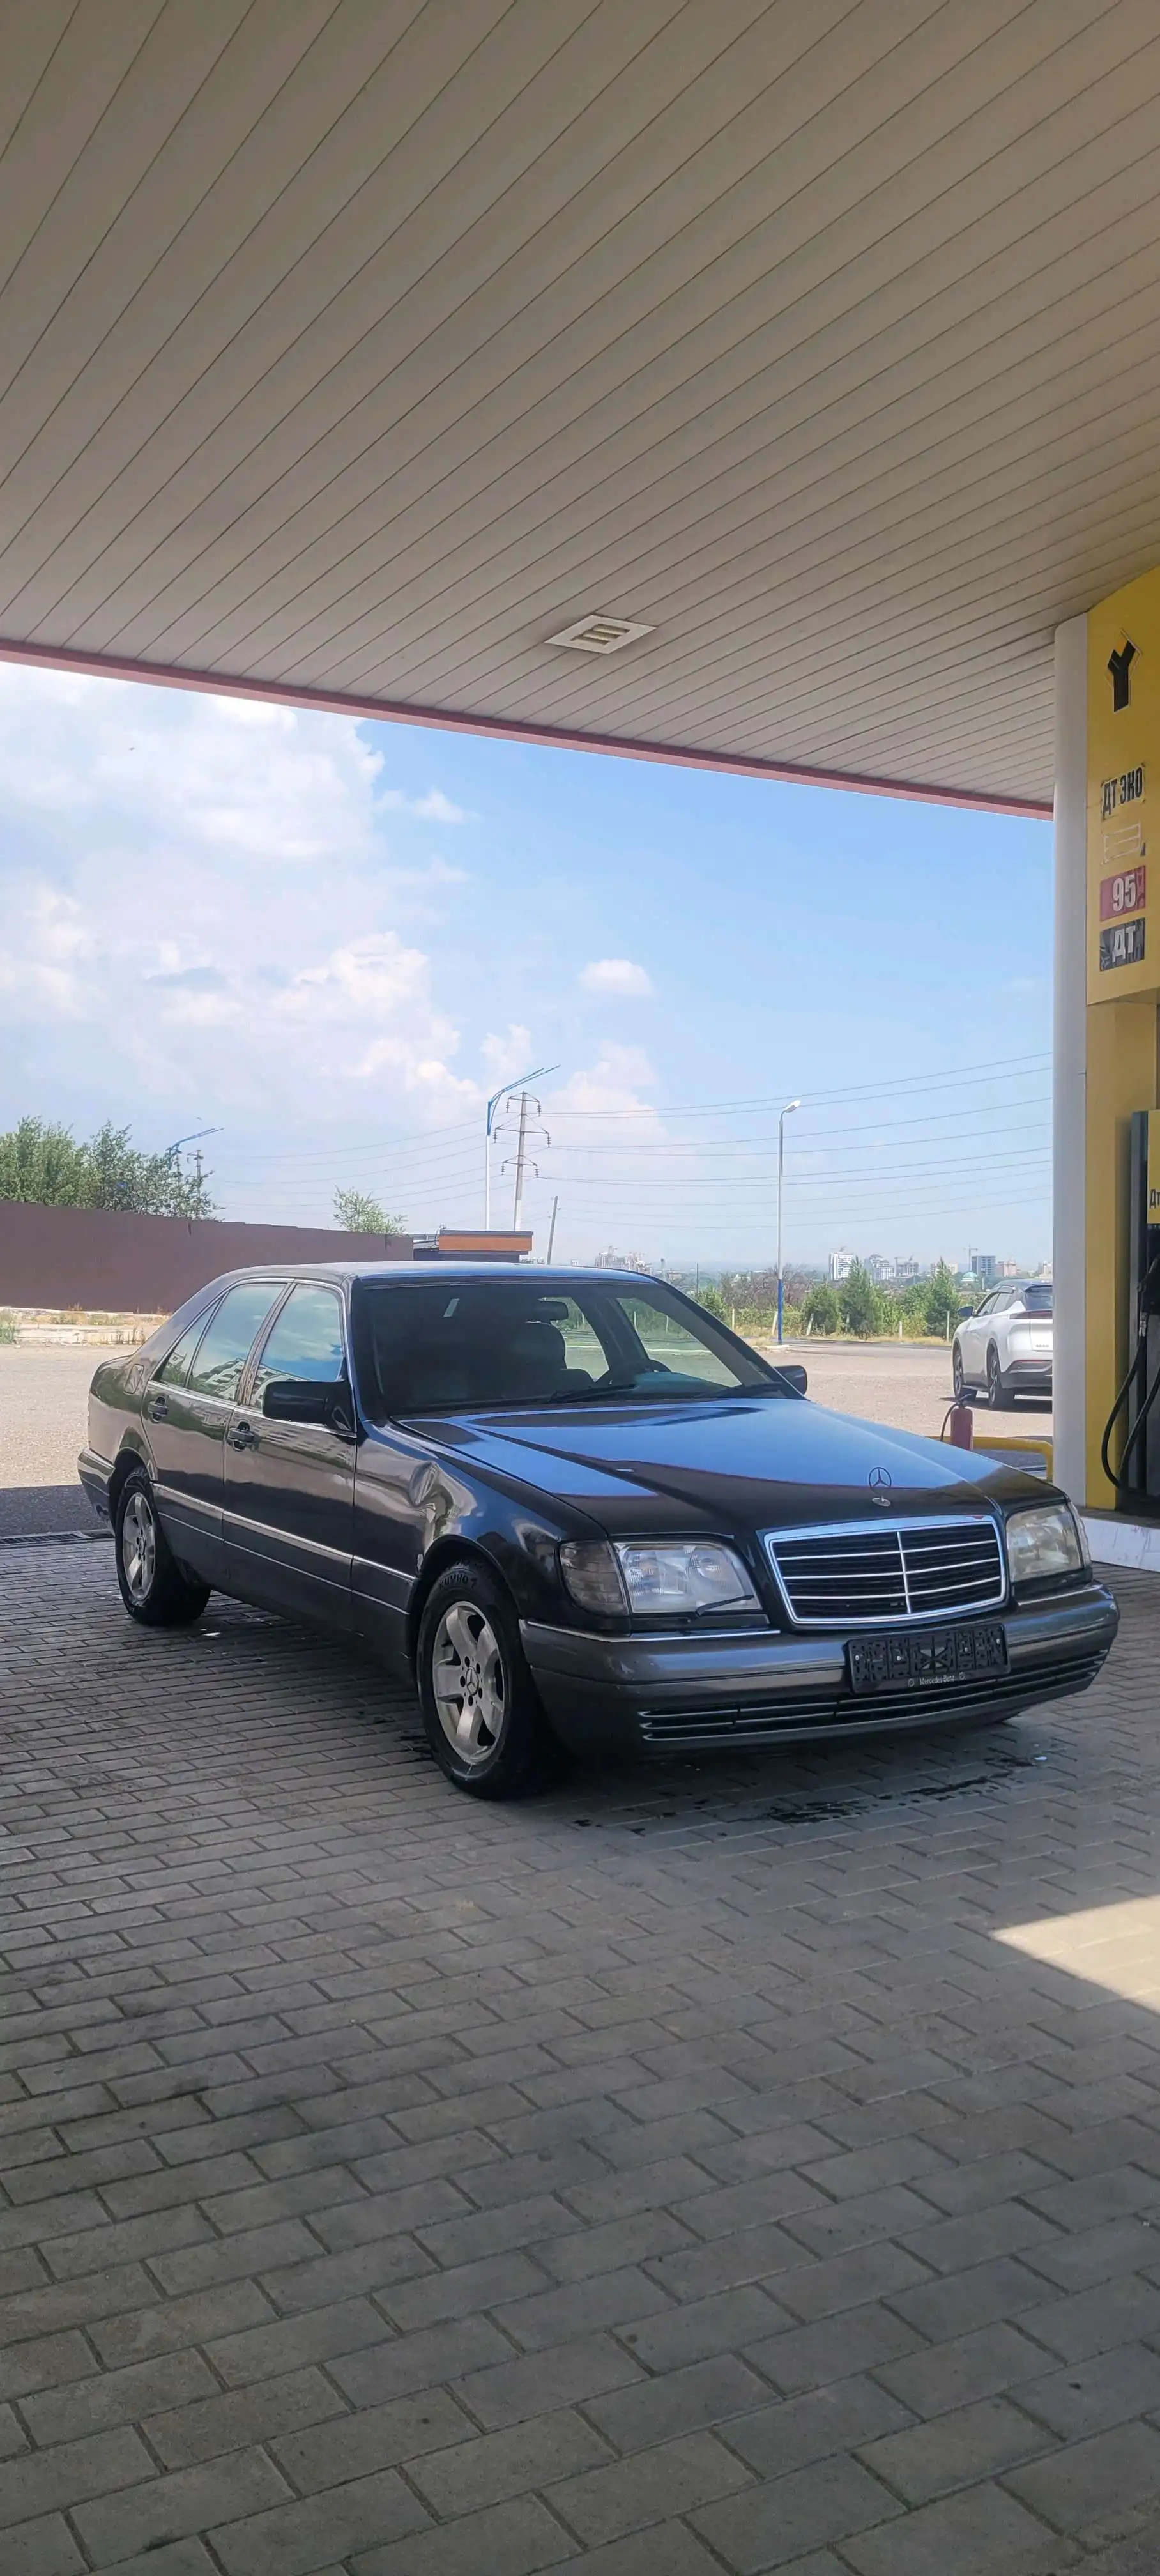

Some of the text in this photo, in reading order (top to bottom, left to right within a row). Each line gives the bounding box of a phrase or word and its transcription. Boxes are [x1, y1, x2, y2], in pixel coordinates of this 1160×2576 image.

[1103, 767, 1142, 818] ДТ ЭКО
[1113, 873, 1136, 912] 95
[1112, 925, 1136, 963] ДТ
